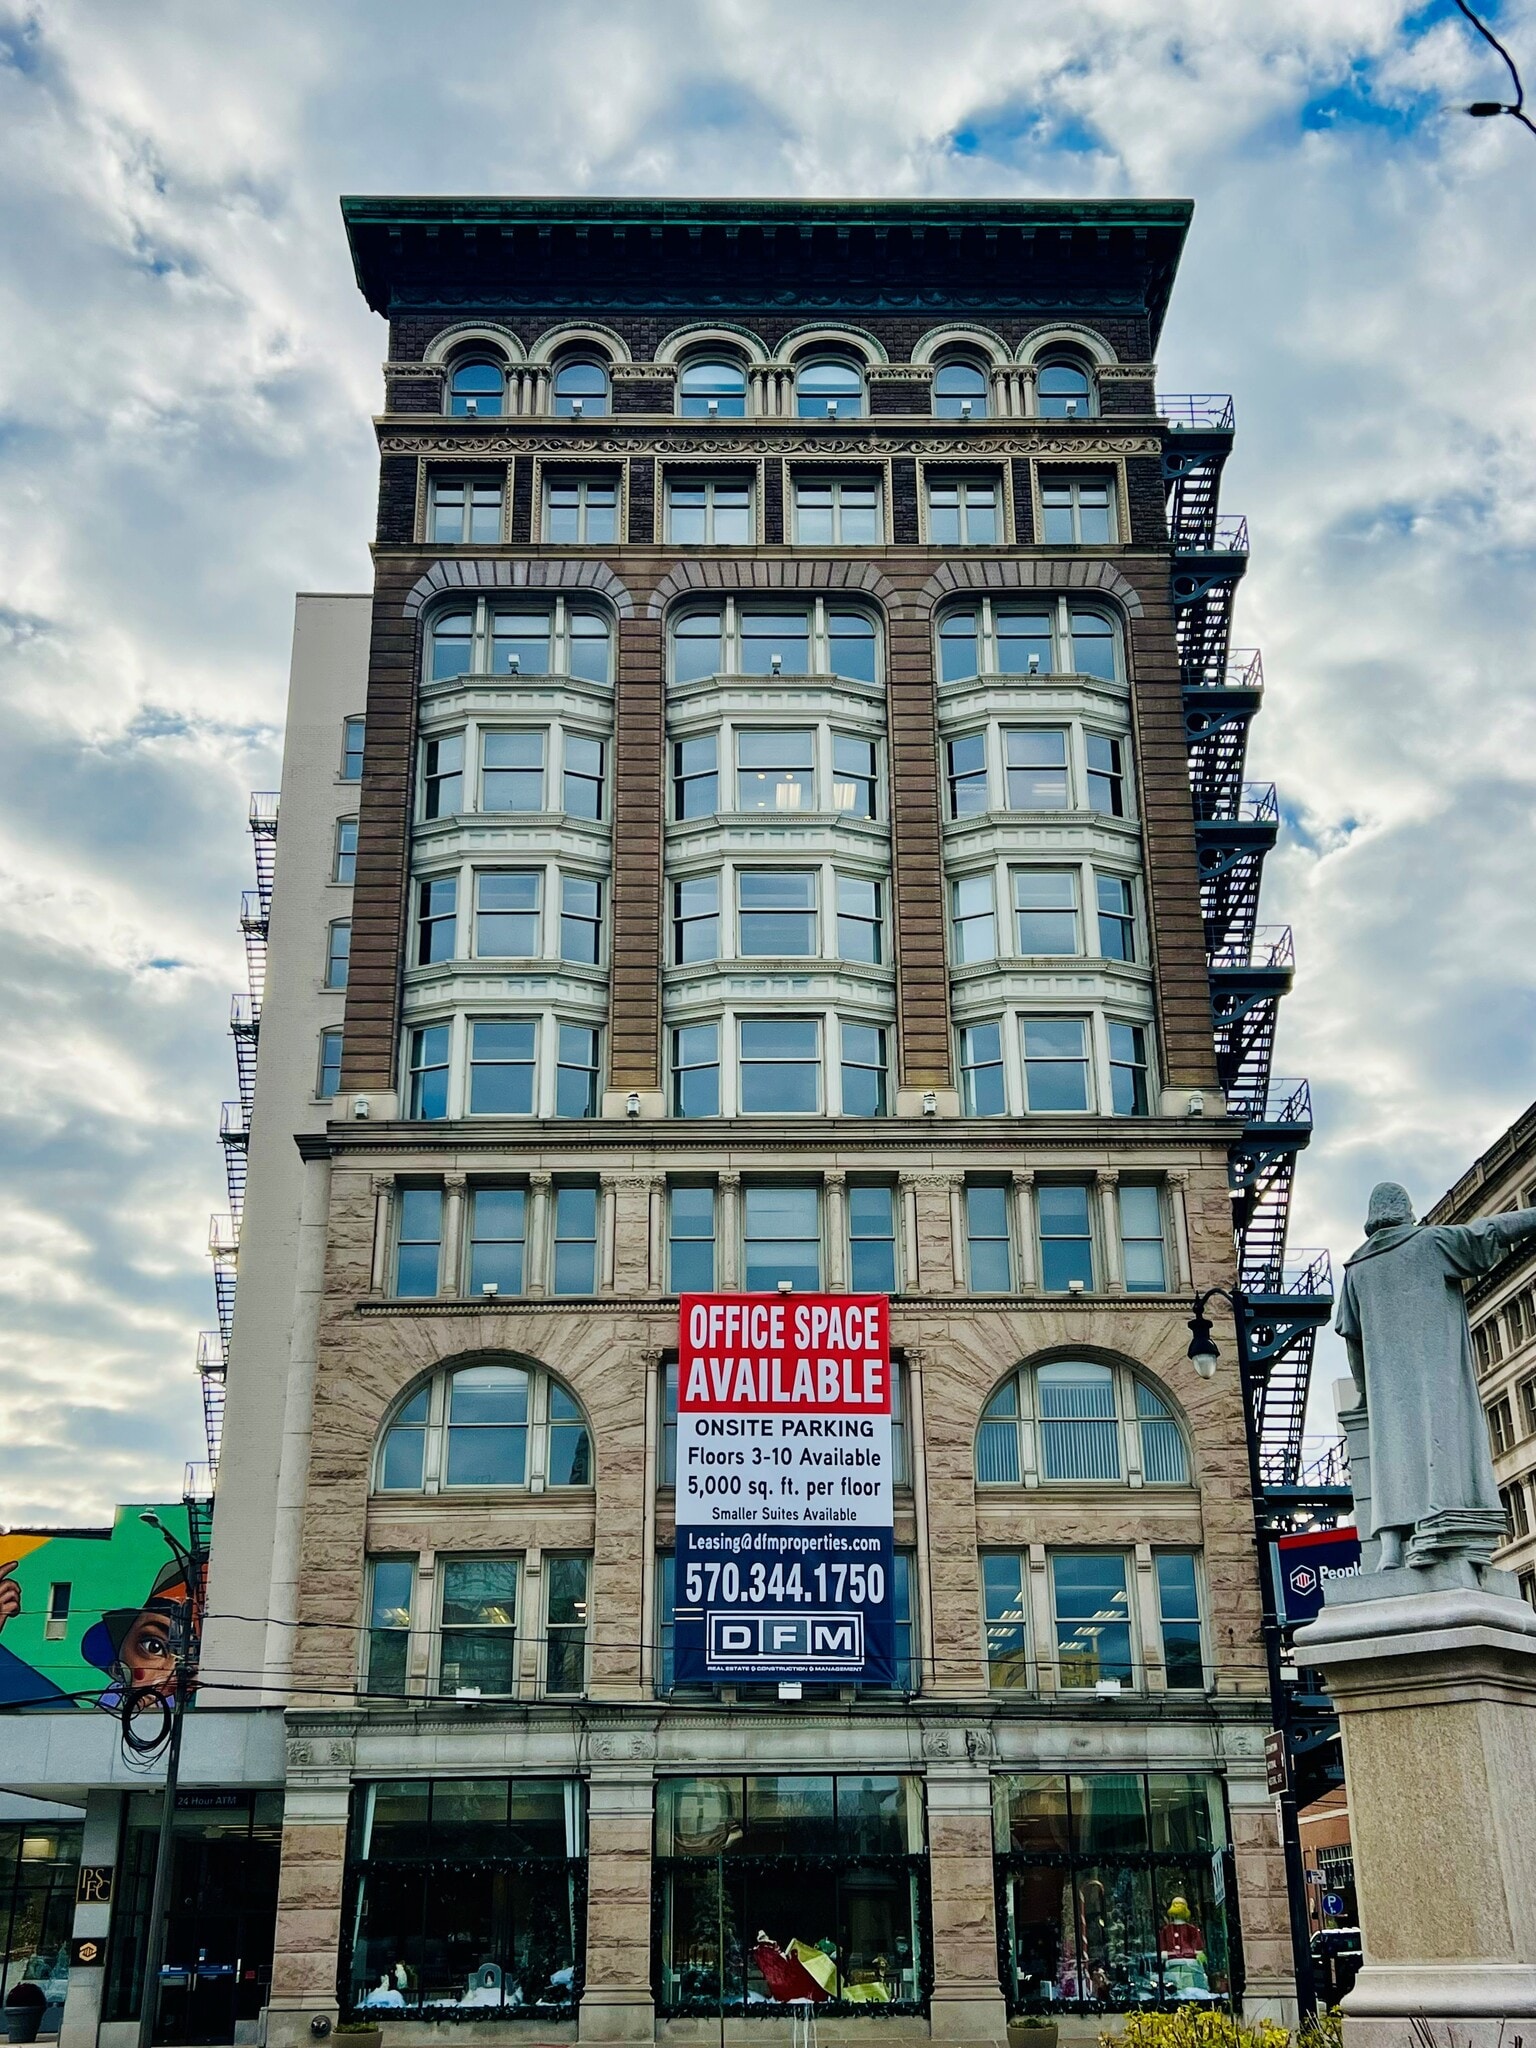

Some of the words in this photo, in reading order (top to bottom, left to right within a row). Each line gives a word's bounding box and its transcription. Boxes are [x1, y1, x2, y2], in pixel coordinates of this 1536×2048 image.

[689, 1304, 785, 1349] OFFICE
[794, 1306, 880, 1351] SPACE
[685, 1357, 884, 1403] AVAILABLE
[695, 1419, 774, 1437] ONSITE
[781, 1419, 874, 1437] PARKING
[688, 1446, 745, 1465] Floors
[751, 1447, 793, 1466] 3-10
[799, 1447, 881, 1467] Available
[688, 1475, 742, 1499] 5,000
[748, 1481, 774, 1501] sq.
[780, 1476, 800, 1496] ft.
[806, 1481, 835, 1501] per
[840, 1476, 881, 1497] floor
[711, 1506, 758, 1521] Smaller
[761, 1507, 799, 1521] Suites
[803, 1507, 857, 1522] Available
[688, 1532, 881, 1555] Leasing@dfmproperties.com
[685, 1562, 885, 1604] 570.344.1750
[722, 1625, 853, 1651] DFM
[177, 1796, 189, 1805] 24
[191, 1796, 214, 1805] Hour
[215, 1796, 237, 1805] ATM
